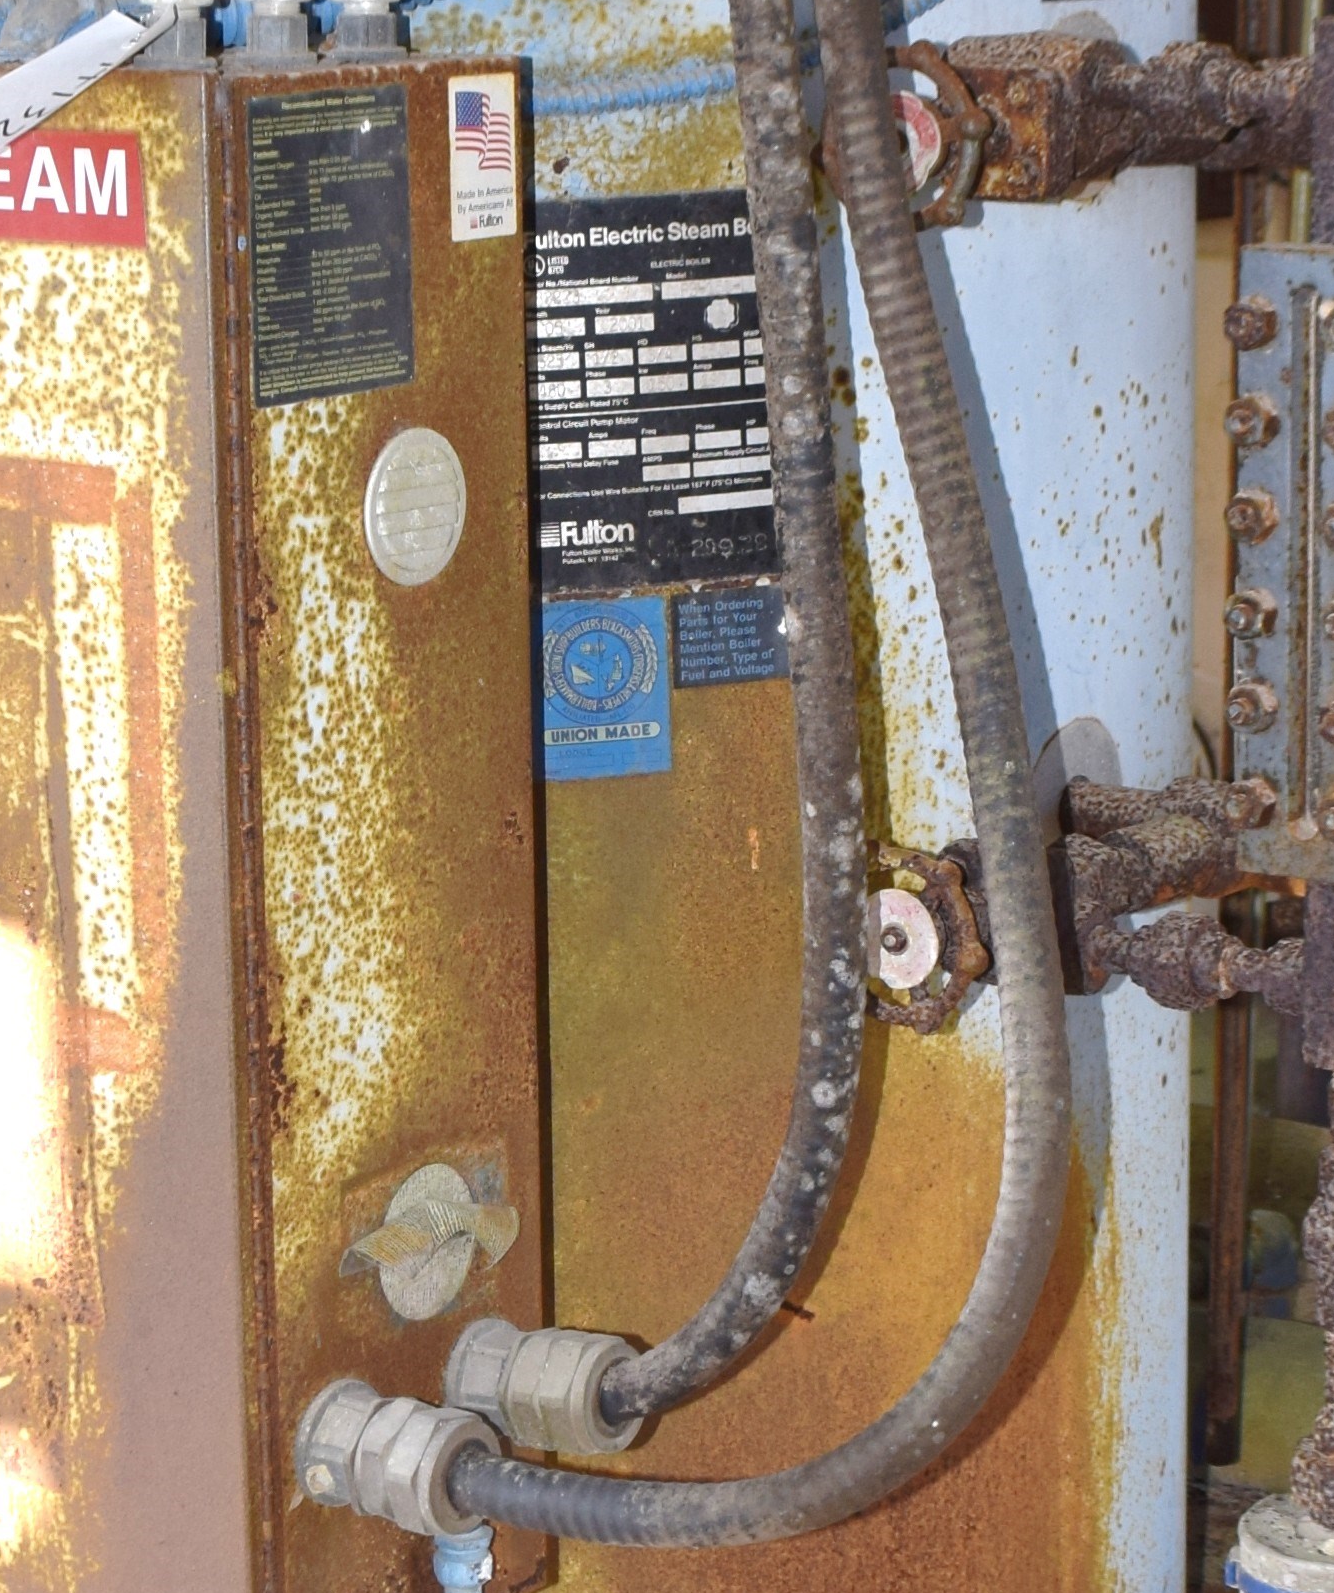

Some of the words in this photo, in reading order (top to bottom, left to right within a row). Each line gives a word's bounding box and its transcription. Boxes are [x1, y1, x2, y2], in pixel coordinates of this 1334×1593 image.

[457, 190, 476, 201] Made
[486, 186, 514, 197] America
[458, 204, 467, 215] By
[468, 200, 505, 212] Americans
[479, 214, 504, 228] Fulton
[536, 229, 586, 249] ulton
[589, 224, 664, 247] Electric
[667, 221, 729, 242] Steam
[590, 418, 614, 428] Pump
[615, 416, 639, 425] Motor
[560, 518, 635, 547] Fulton
[562, 549, 583, 558] Fulton
[678, 602, 711, 615] When
[714, 598, 765, 612] Ordering
[679, 616, 709, 628] Parts
[712, 614, 729, 626] for
[732, 612, 759, 625] Your
[719, 625, 757, 638] Please
[680, 641, 725, 654] Mention
[729, 637, 762, 649] Boiler
[680, 654, 727, 668] Number,
[731, 652, 758, 665] Type
[761, 647, 775, 660] of
[681, 669, 706, 682] Fuel
[709, 667, 731, 679] and
[734, 663, 776, 678] Voltage
[550, 727, 599, 744] UNION
[605, 723, 651, 740] MADE
